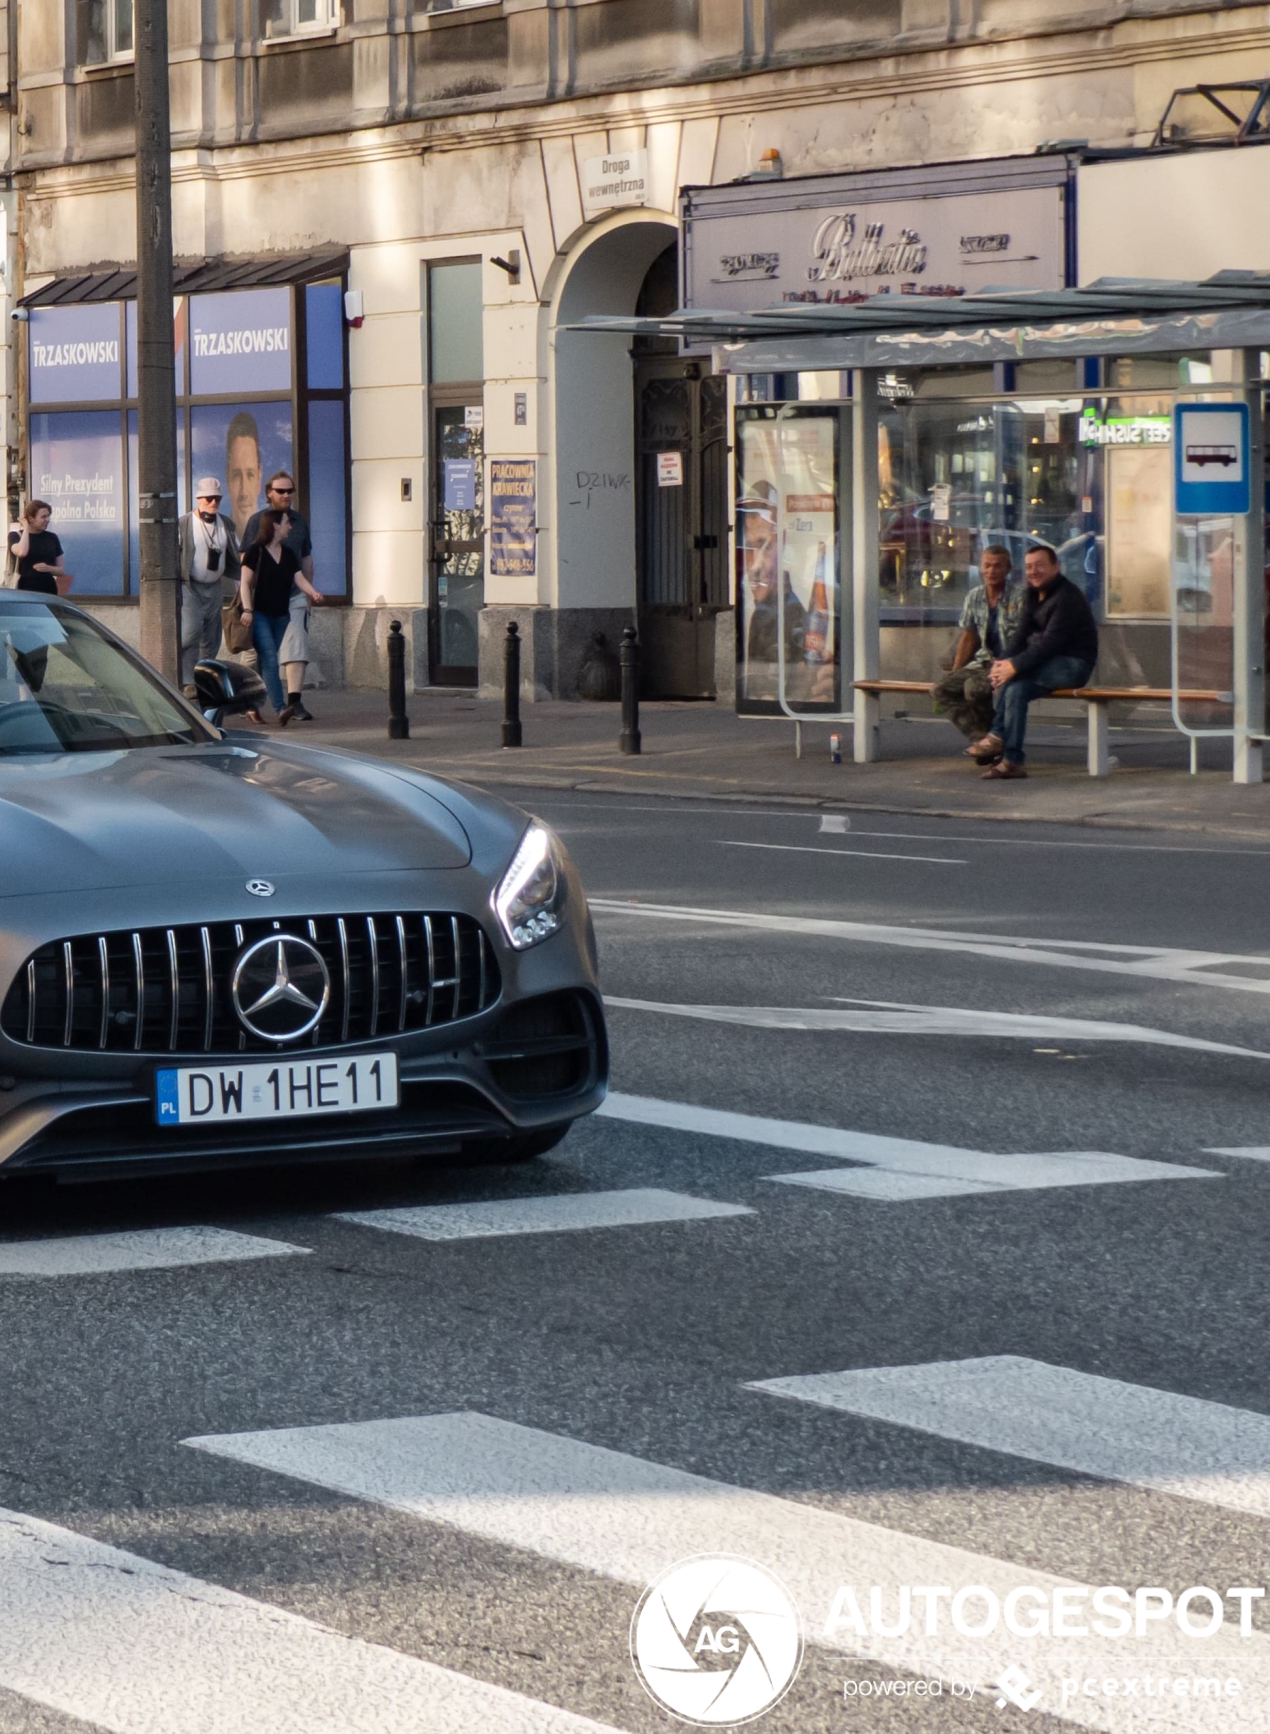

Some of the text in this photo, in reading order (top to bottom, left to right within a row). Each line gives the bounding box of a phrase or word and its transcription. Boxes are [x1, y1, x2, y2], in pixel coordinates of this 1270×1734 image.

[602, 159, 630, 175] Droga
[588, 178, 644, 198] wewnętrzna
[194, 328, 288, 357] TRZASKOWSKI
[33, 341, 119, 367] TRZASKOWSKI
[492, 464, 535, 479] PRACOWNIA
[40, 472, 114, 497] Silny Prezydent
[492, 482, 534, 496] KRAWIECKA
[84, 500, 116, 519] Polska
[188, 1059, 382, 1116] DW 1HE11
[161, 1103, 177, 1115] PL
